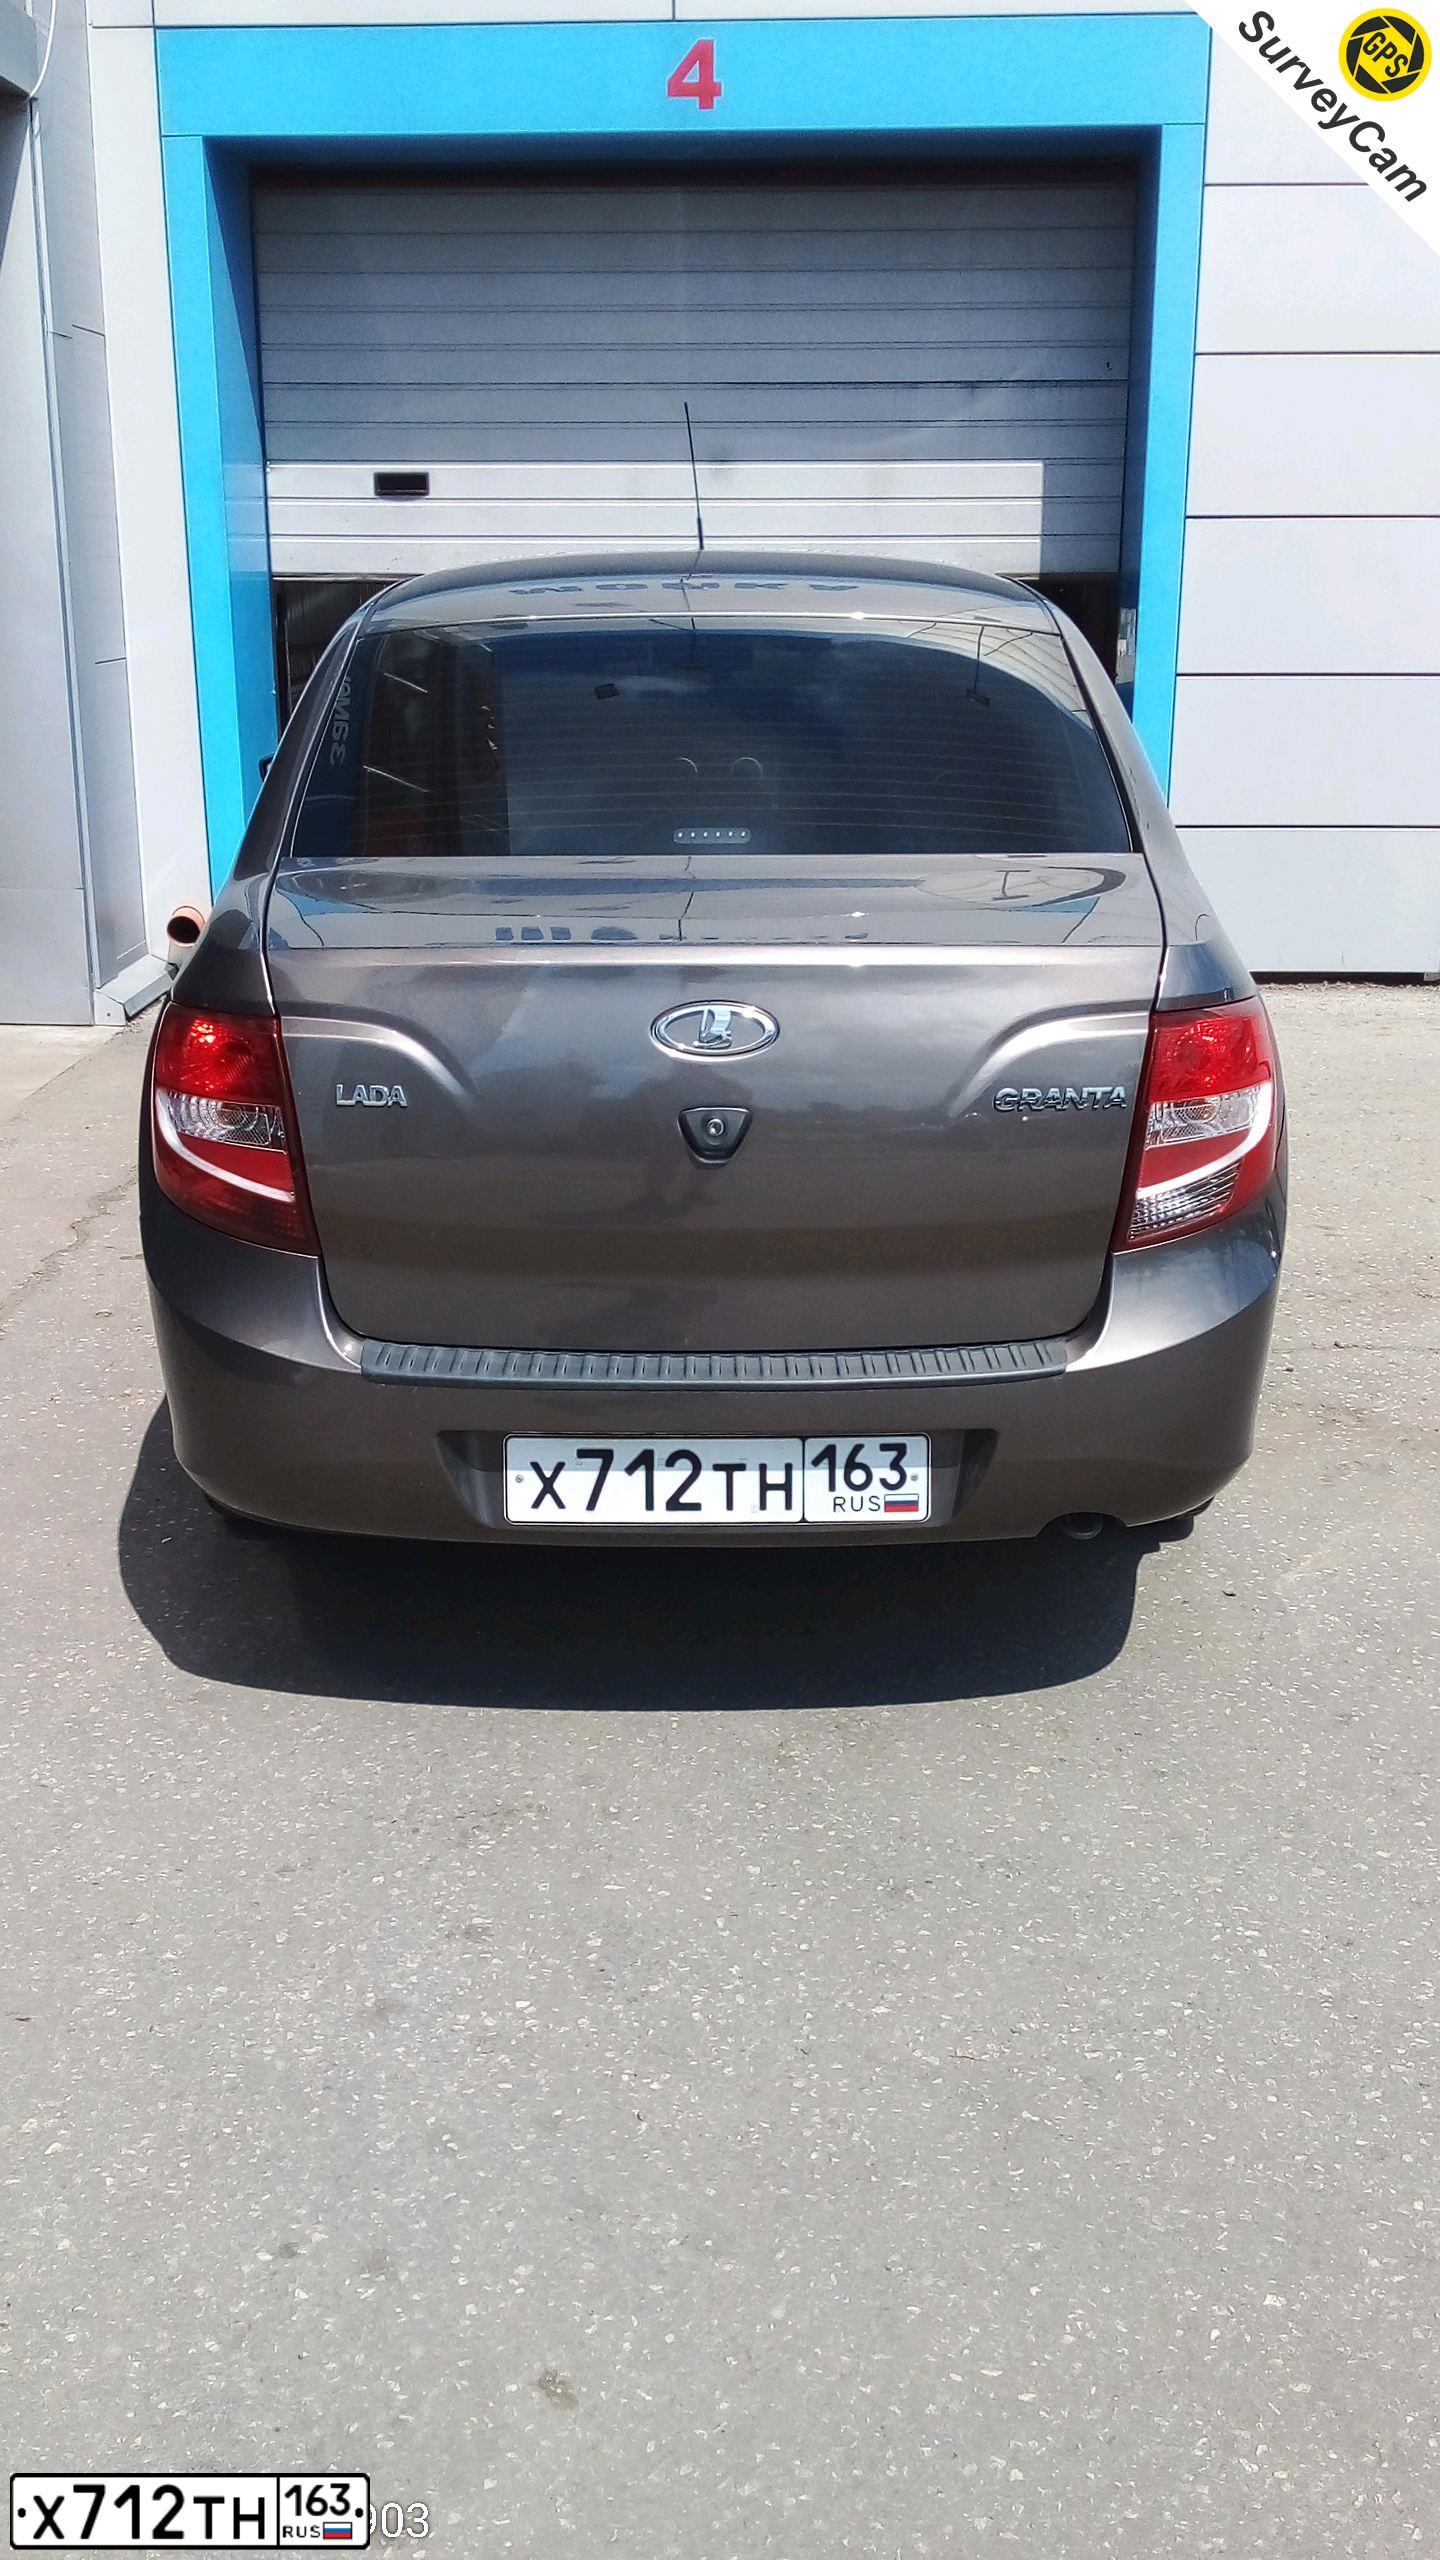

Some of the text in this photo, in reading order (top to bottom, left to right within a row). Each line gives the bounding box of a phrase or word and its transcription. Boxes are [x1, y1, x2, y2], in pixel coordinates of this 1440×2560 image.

[667, 38, 722, 110] 4
[335, 1083, 409, 1108] LADA
[993, 1086, 1128, 1113] GRANTA
[810, 1442, 908, 1492] 163
[833, 1495, 881, 1513] RUS
